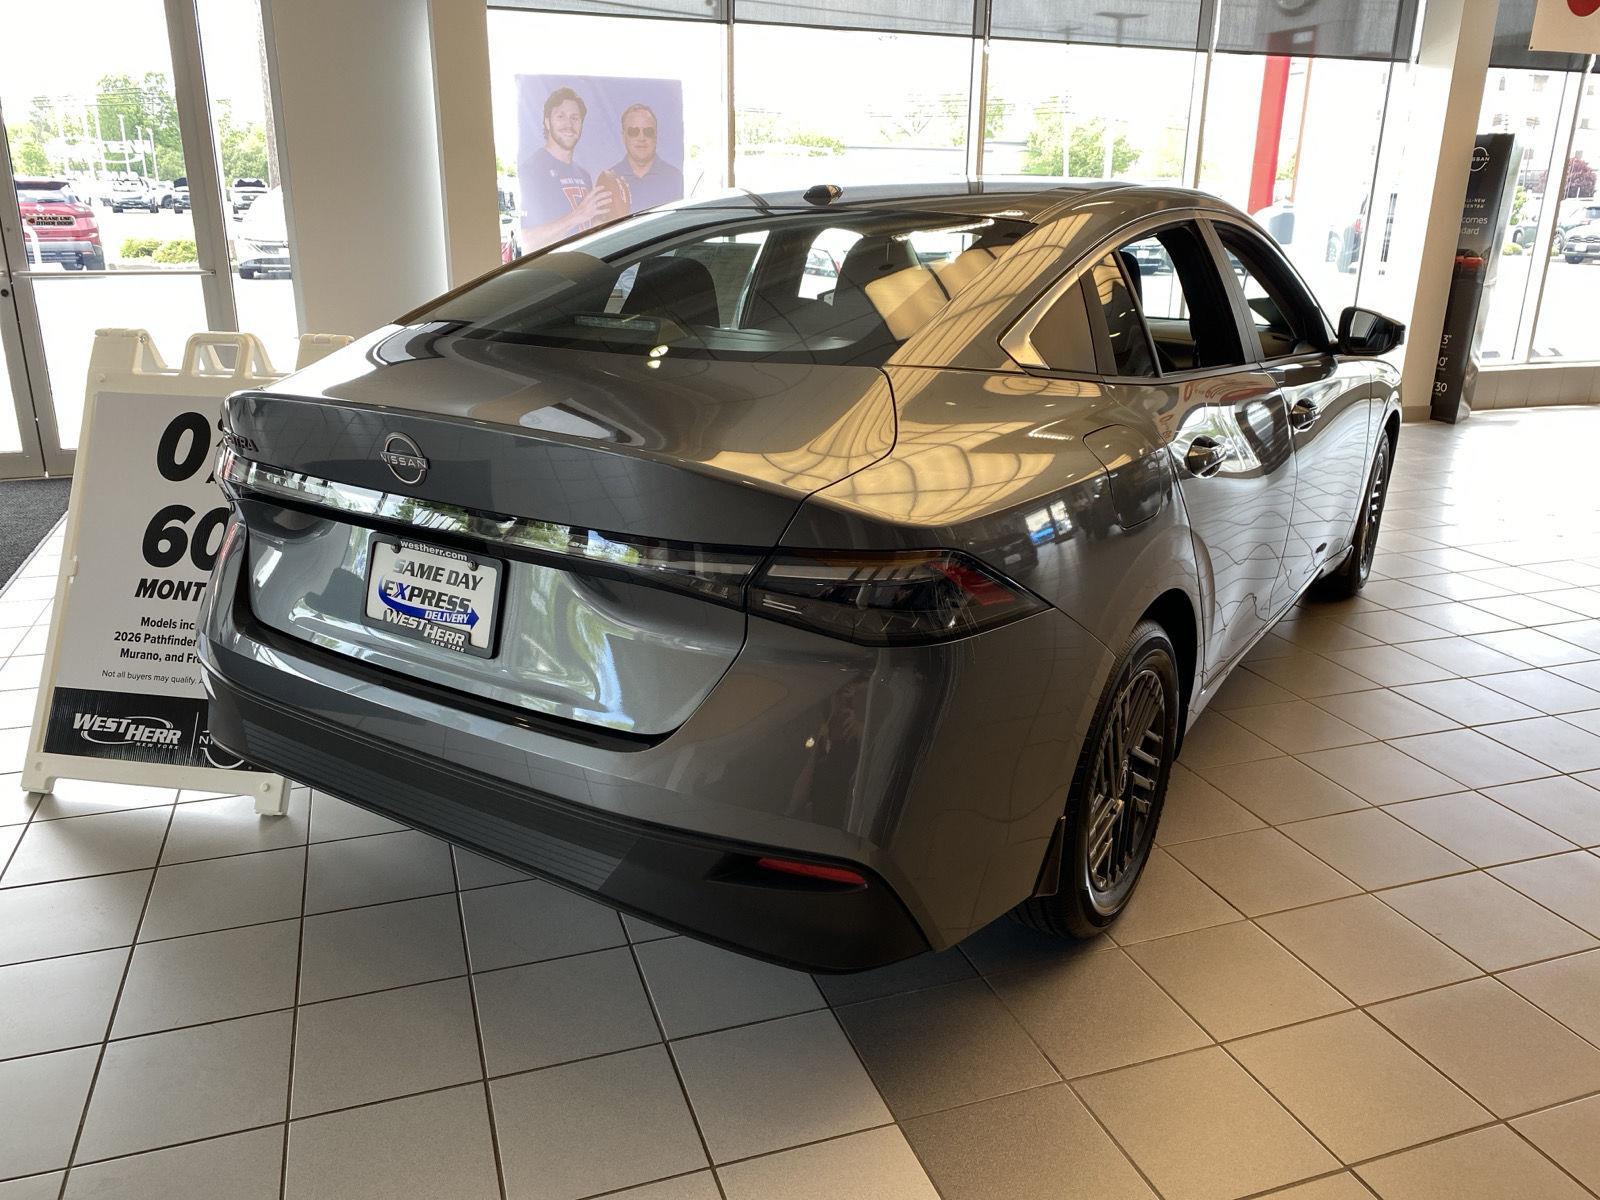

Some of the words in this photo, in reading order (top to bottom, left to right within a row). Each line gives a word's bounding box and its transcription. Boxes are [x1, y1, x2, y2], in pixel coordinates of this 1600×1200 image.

[380, 451, 427, 470] NISSAN
[400, 540, 467, 562] westherr.com
[392, 559, 446, 583] SAME
[446, 569, 484, 591] DAY
[135, 578, 207, 602] MONT
[383, 580, 472, 613] EXPRESS
[141, 616, 177, 629] Models
[424, 610, 471, 624] DELIVERY
[114, 631, 141, 643] 2026
[143, 633, 197, 646] Pathfinder
[431, 639, 445, 647] NEW
[448, 644, 465, 653] YORK
[120, 648, 162, 662] Murano,
[165, 653, 184, 663] and
[102, 670, 115, 678] Not
[127, 672, 152, 681] buyers
[171, 676, 197, 685] qualify.
